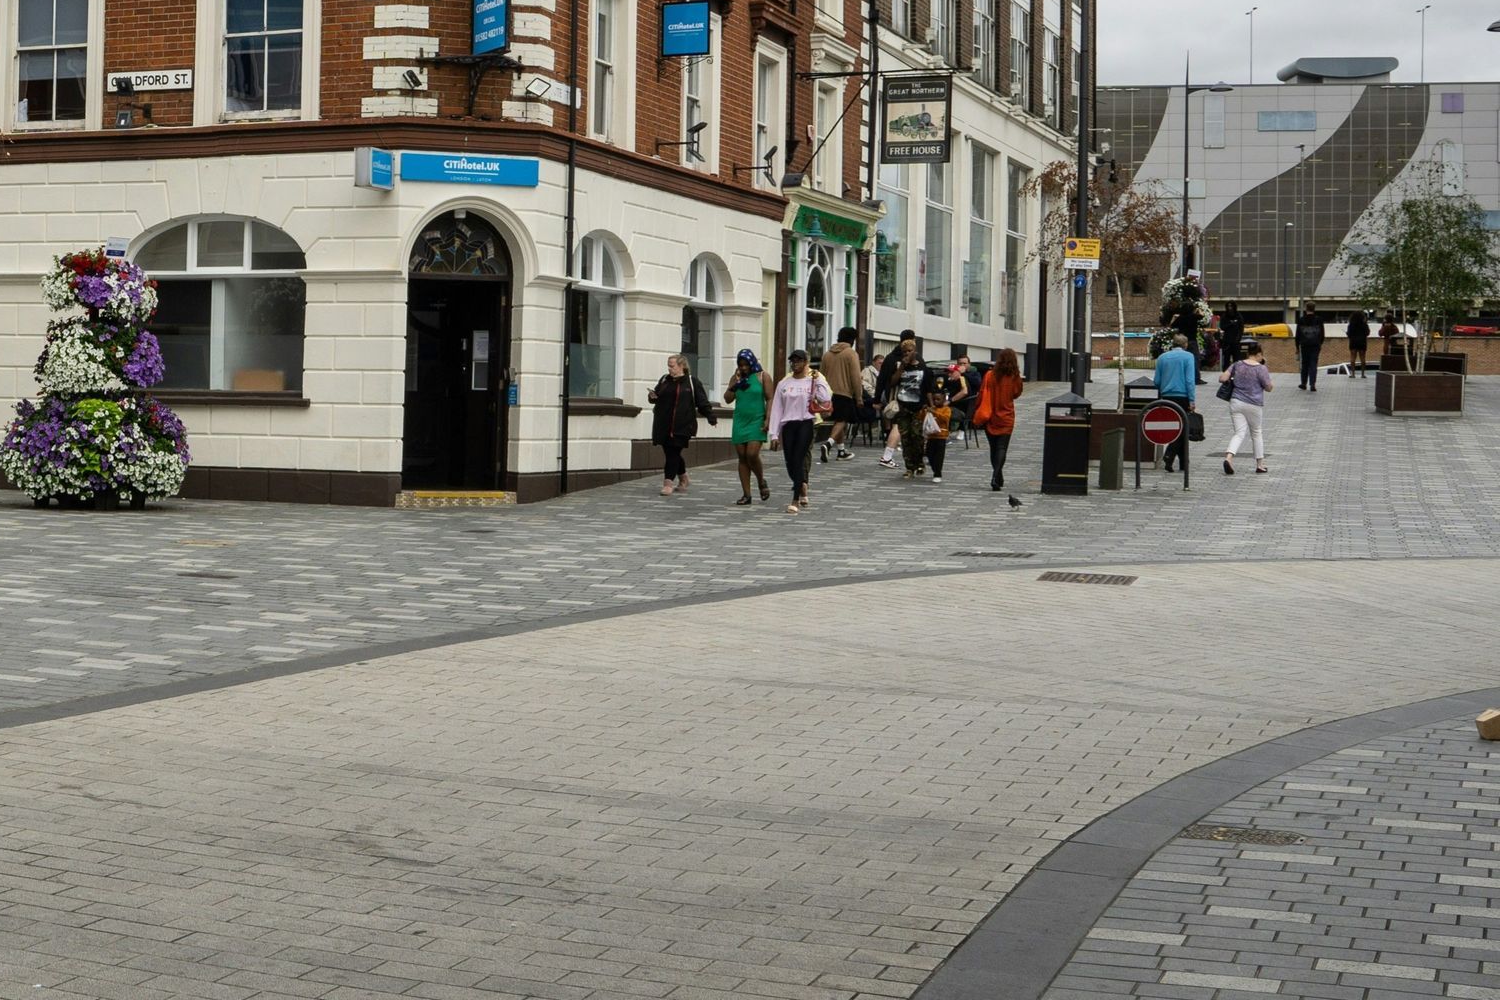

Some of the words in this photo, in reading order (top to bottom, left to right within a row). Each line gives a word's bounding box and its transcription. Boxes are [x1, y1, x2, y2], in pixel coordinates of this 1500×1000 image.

[911, 87, 945, 95] NORTHERN
[889, 146, 910, 156] FREE
[912, 146, 941, 155] HOUSE
